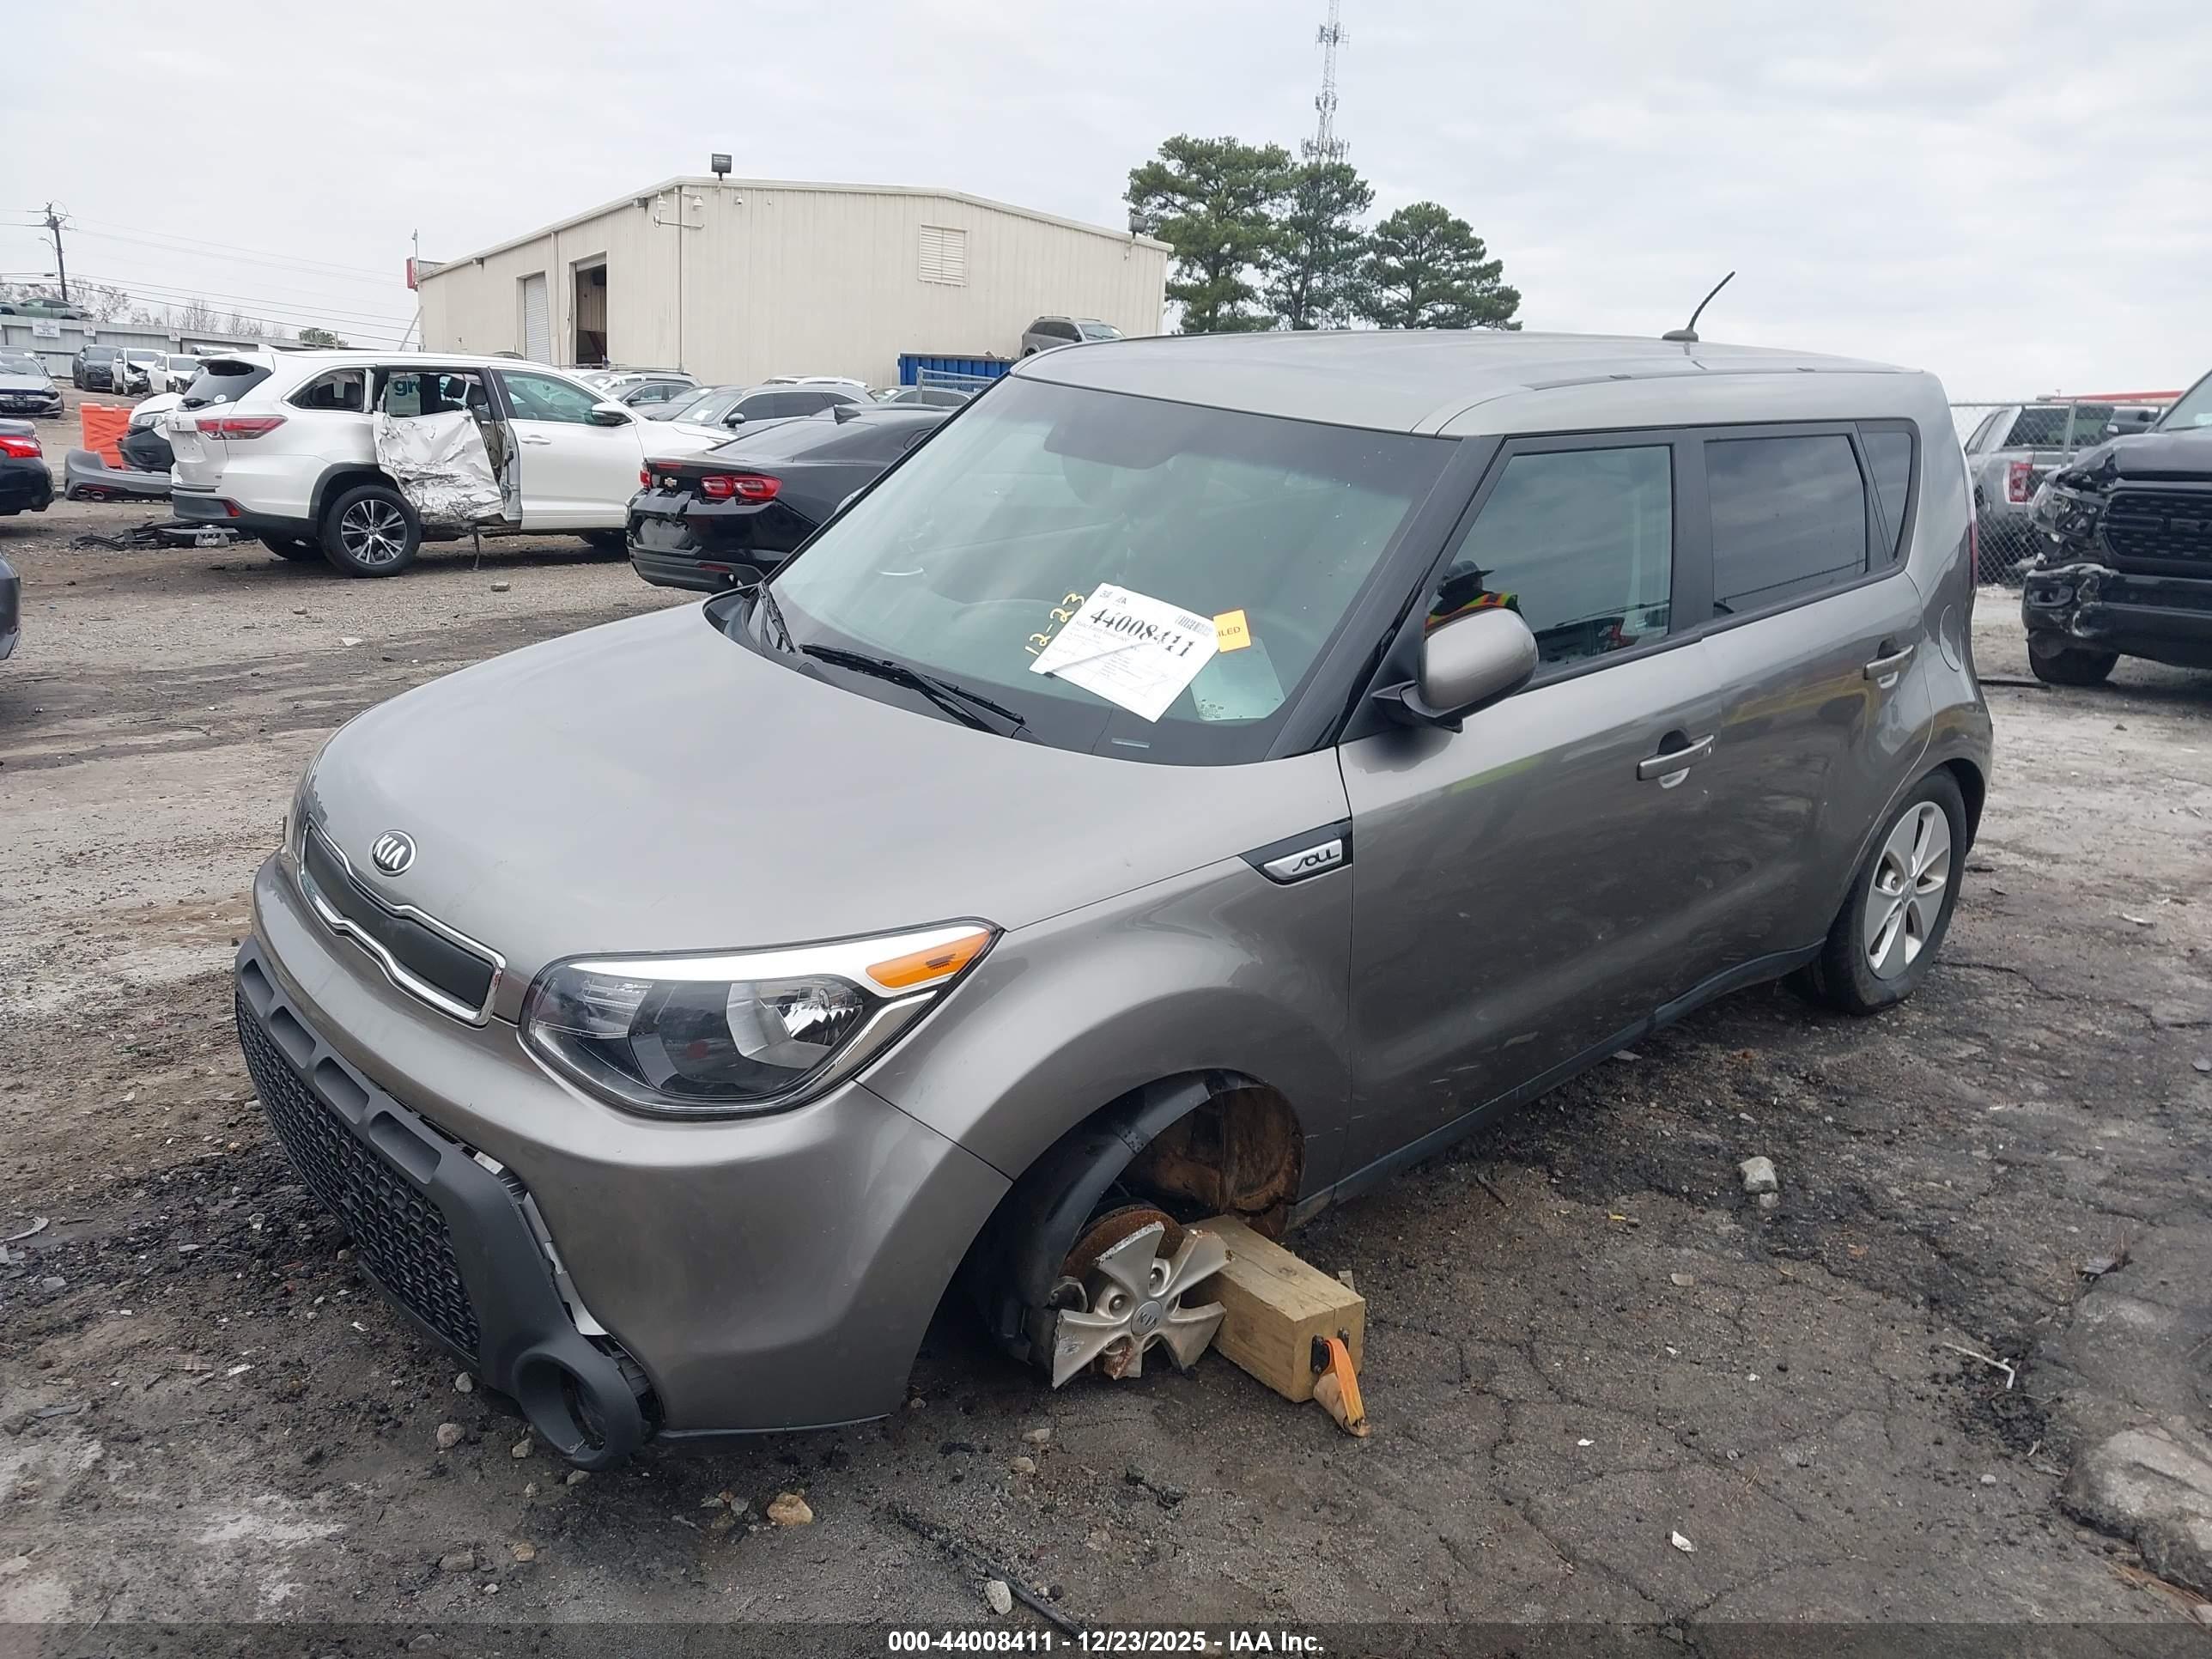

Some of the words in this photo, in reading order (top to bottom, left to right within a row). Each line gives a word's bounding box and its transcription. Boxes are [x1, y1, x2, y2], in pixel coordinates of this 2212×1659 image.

[1024, 592, 1085, 655] 12-23
[373, 834, 408, 870] KIA
[1292, 849, 1340, 872] SOUL
[1139, 1312, 1158, 1327] KIA
